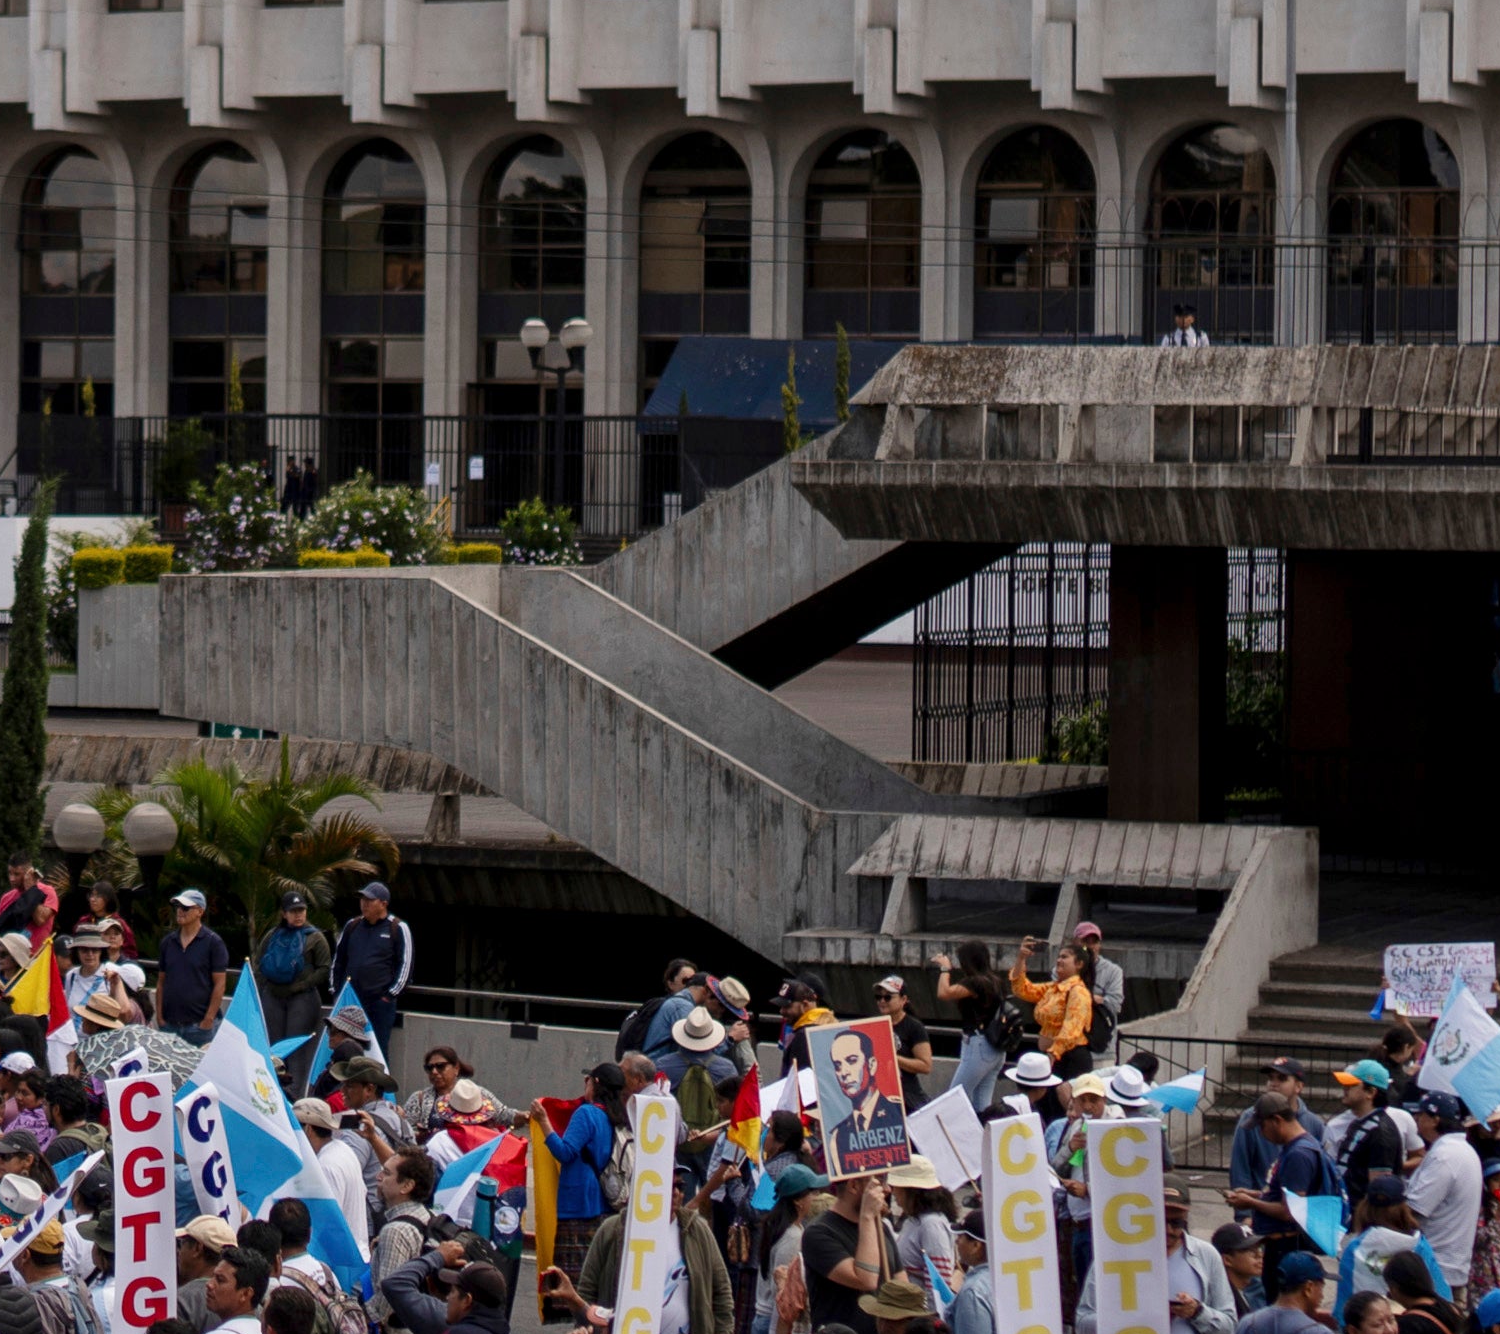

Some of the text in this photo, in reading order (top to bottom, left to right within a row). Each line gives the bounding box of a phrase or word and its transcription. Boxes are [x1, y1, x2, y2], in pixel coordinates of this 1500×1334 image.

[849, 1124, 906, 1151] ARBENZ
[844, 1144, 910, 1168] PRESENTE
[118, 1080, 169, 1328] CGTG
